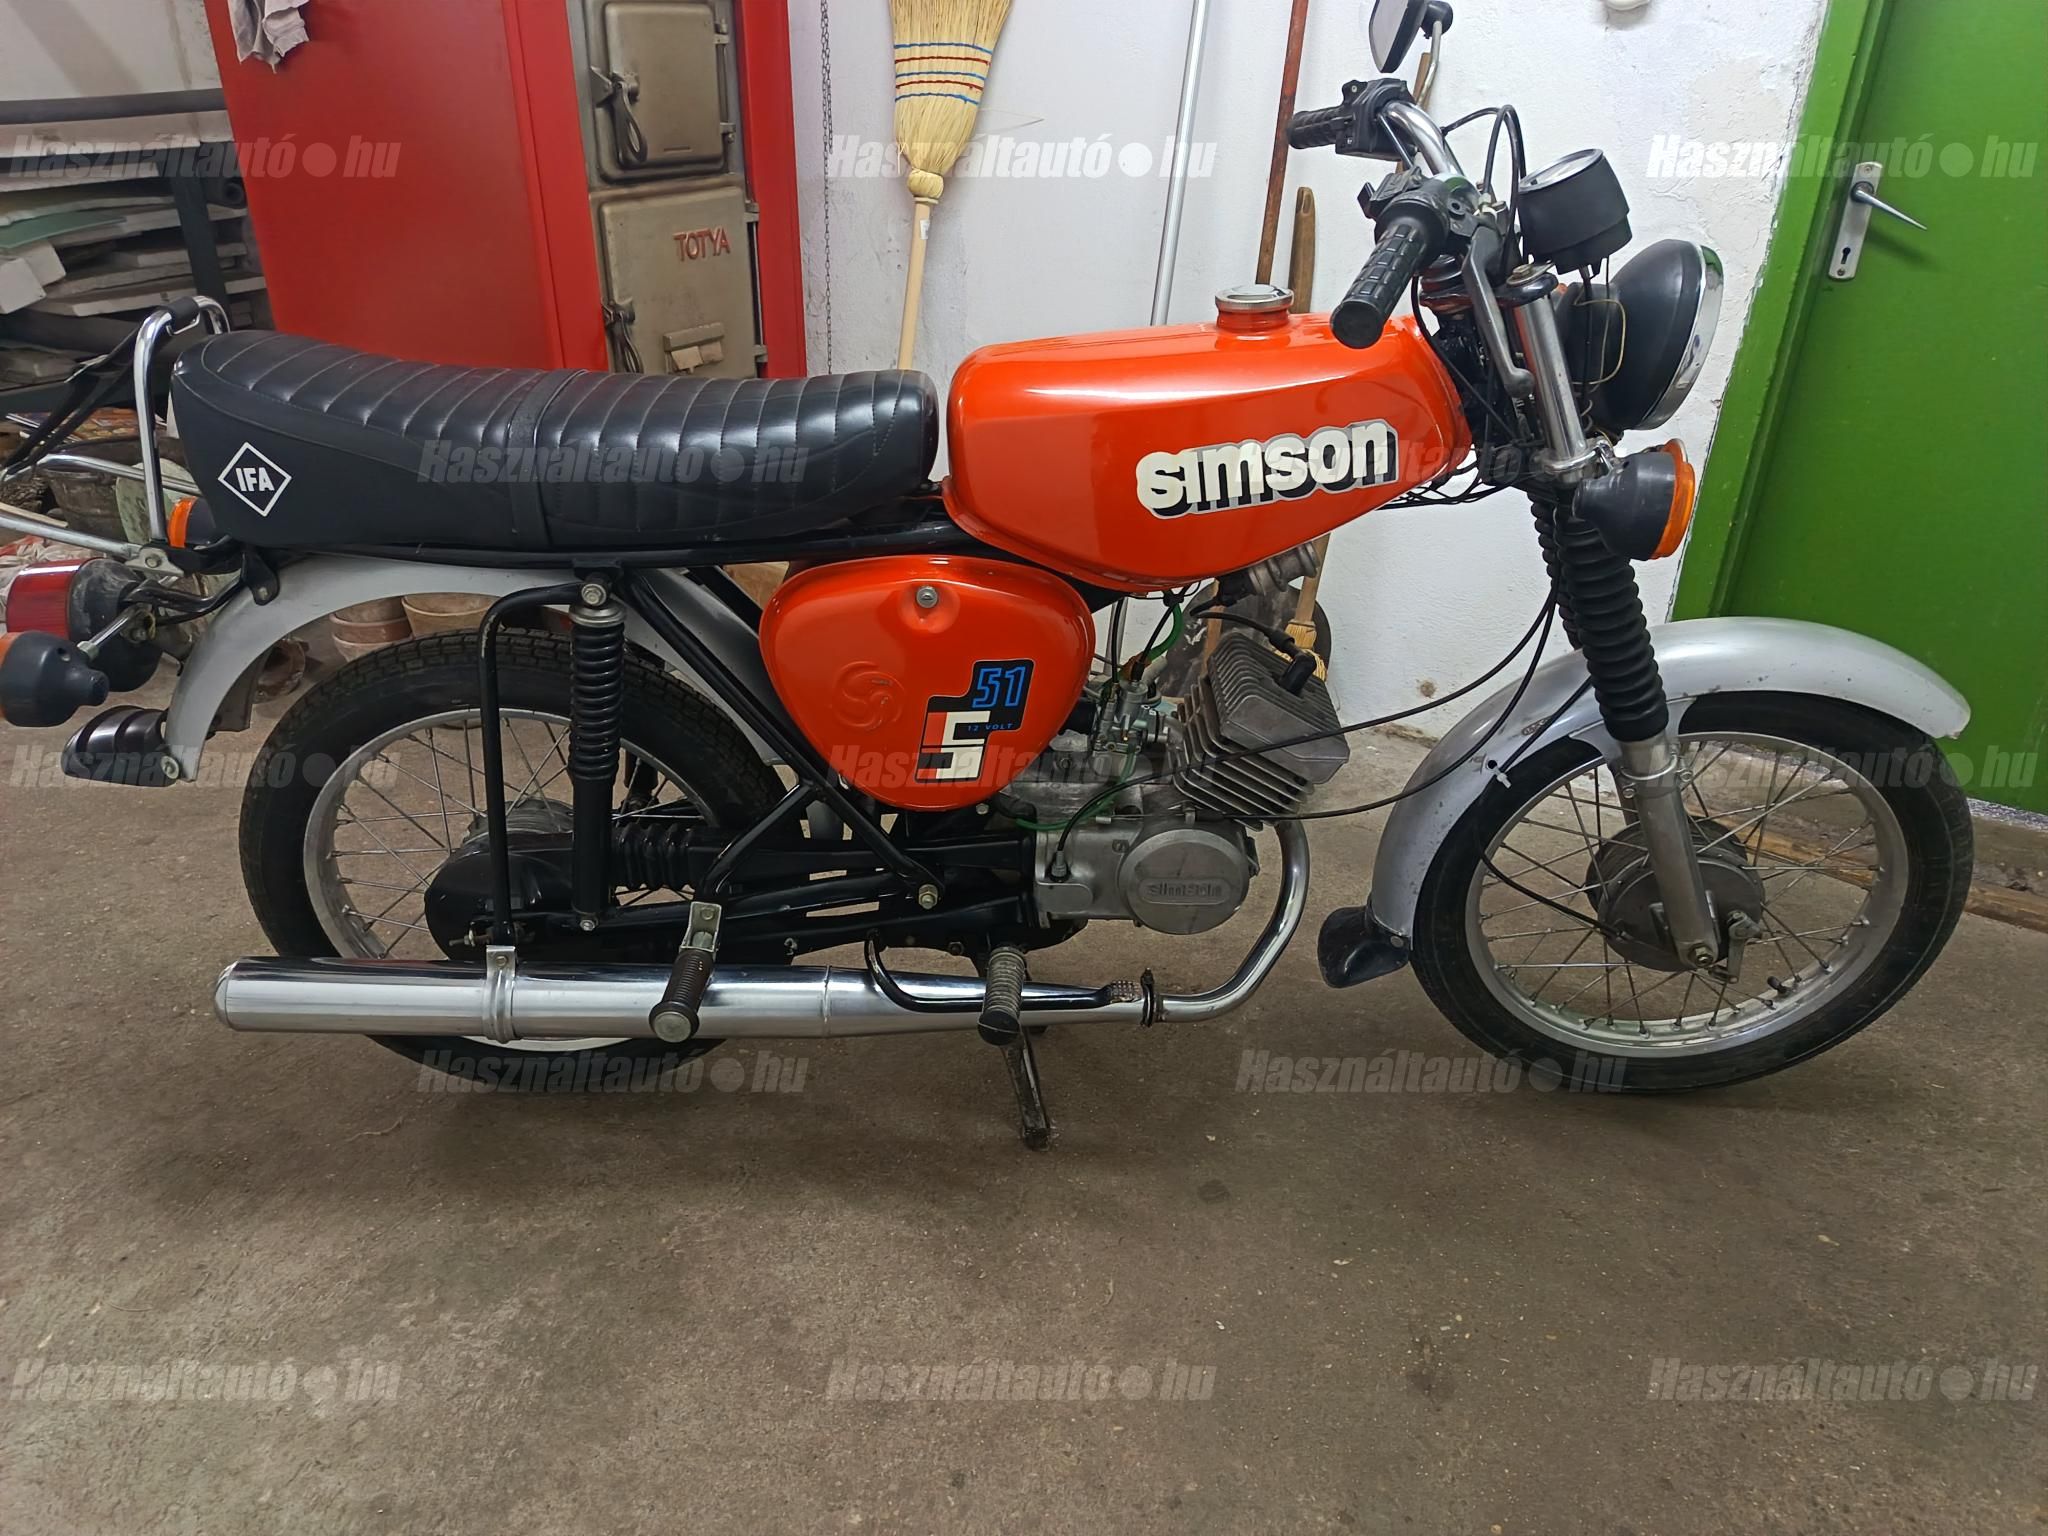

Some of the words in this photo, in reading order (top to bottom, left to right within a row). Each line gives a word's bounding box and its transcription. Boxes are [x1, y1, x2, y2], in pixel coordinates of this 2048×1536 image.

[673, 226, 731, 262] TOTYA
[235, 467, 275, 492] IFA
[1137, 420, 1398, 518] simson
[971, 666, 1026, 708] 51
